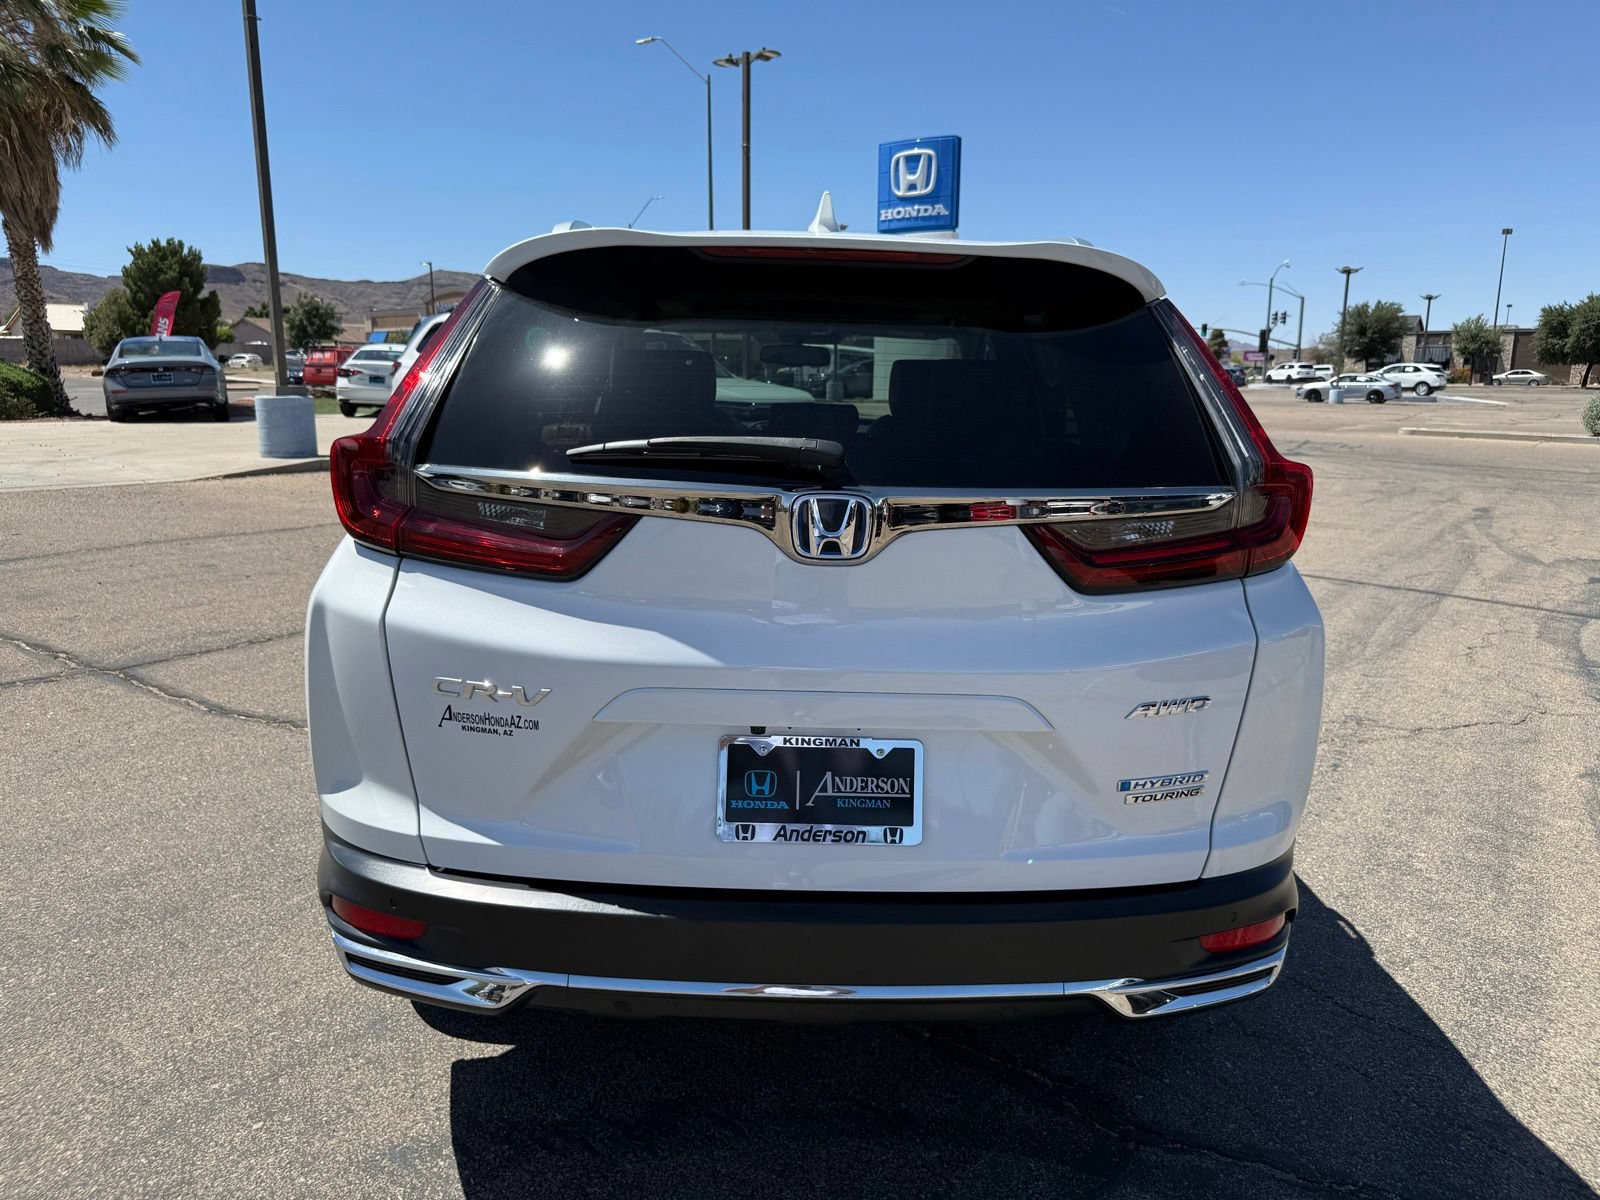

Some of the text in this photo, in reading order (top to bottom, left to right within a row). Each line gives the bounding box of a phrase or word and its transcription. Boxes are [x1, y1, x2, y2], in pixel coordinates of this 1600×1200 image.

[880, 204, 949, 220] HONDA
[432, 676, 552, 706] CR-V
[1124, 695, 1212, 720] AWD
[462, 725, 501, 736] KINGMAN,
[782, 737, 861, 748] KINGMAN
[805, 771, 910, 806] ANDERSON
[1132, 774, 1205, 790] HYBRID
[1132, 787, 1201, 803] TOURING
[730, 799, 789, 810] HONDA
[837, 798, 891, 809] KINGMAN
[772, 825, 867, 844] Anderson
